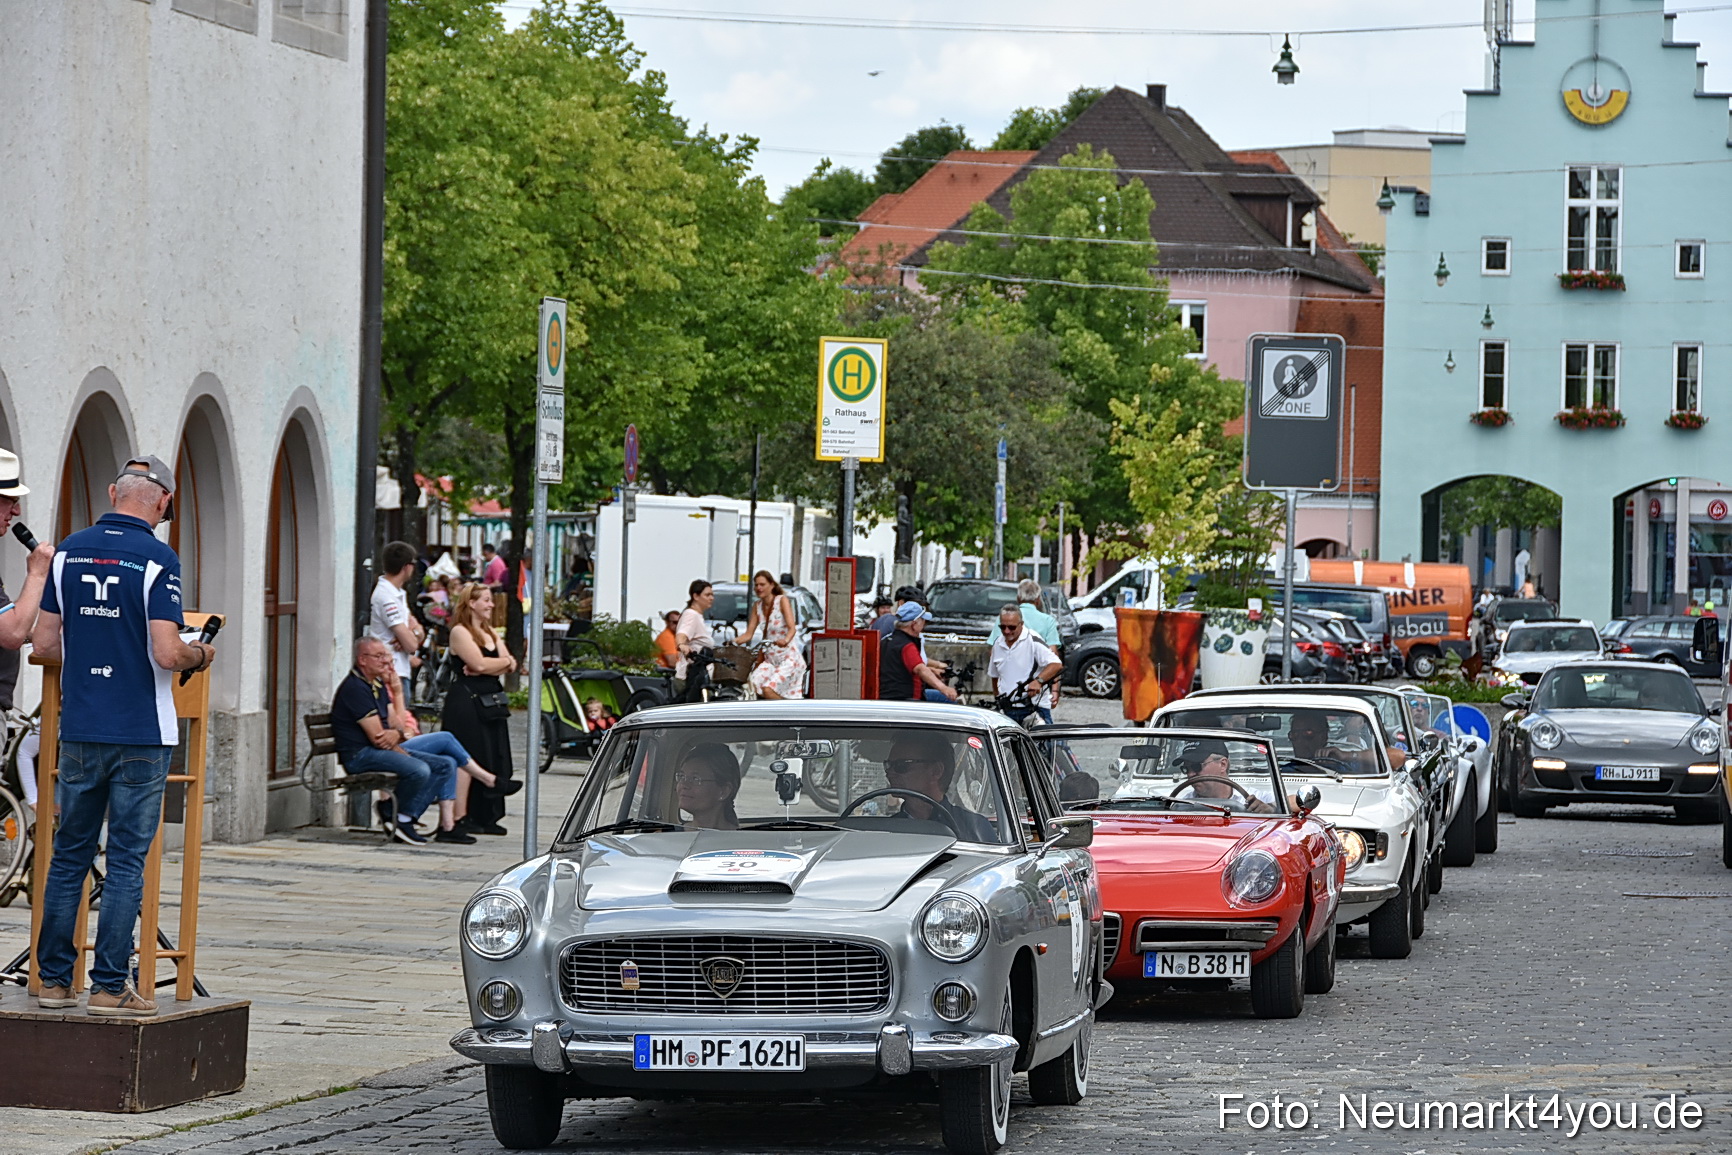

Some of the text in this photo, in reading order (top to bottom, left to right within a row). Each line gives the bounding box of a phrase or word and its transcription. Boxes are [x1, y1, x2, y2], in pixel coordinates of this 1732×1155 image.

[842, 359, 862, 390] H
[834, 408, 867, 417] Rathaus
[1278, 402, 1311, 413] ZONE
[119, 560, 145, 572] RACING
[80, 605, 119, 618] randstad
[91, 667, 103, 675] BT
[1602, 768, 1614, 778] RH
[1622, 768, 1634, 779] LJ
[1636, 769, 1653, 779] 911
[1161, 955, 1174, 974] N
[652, 1039, 800, 1066] HM PF 162H
[639, 1055, 646, 1063] D
